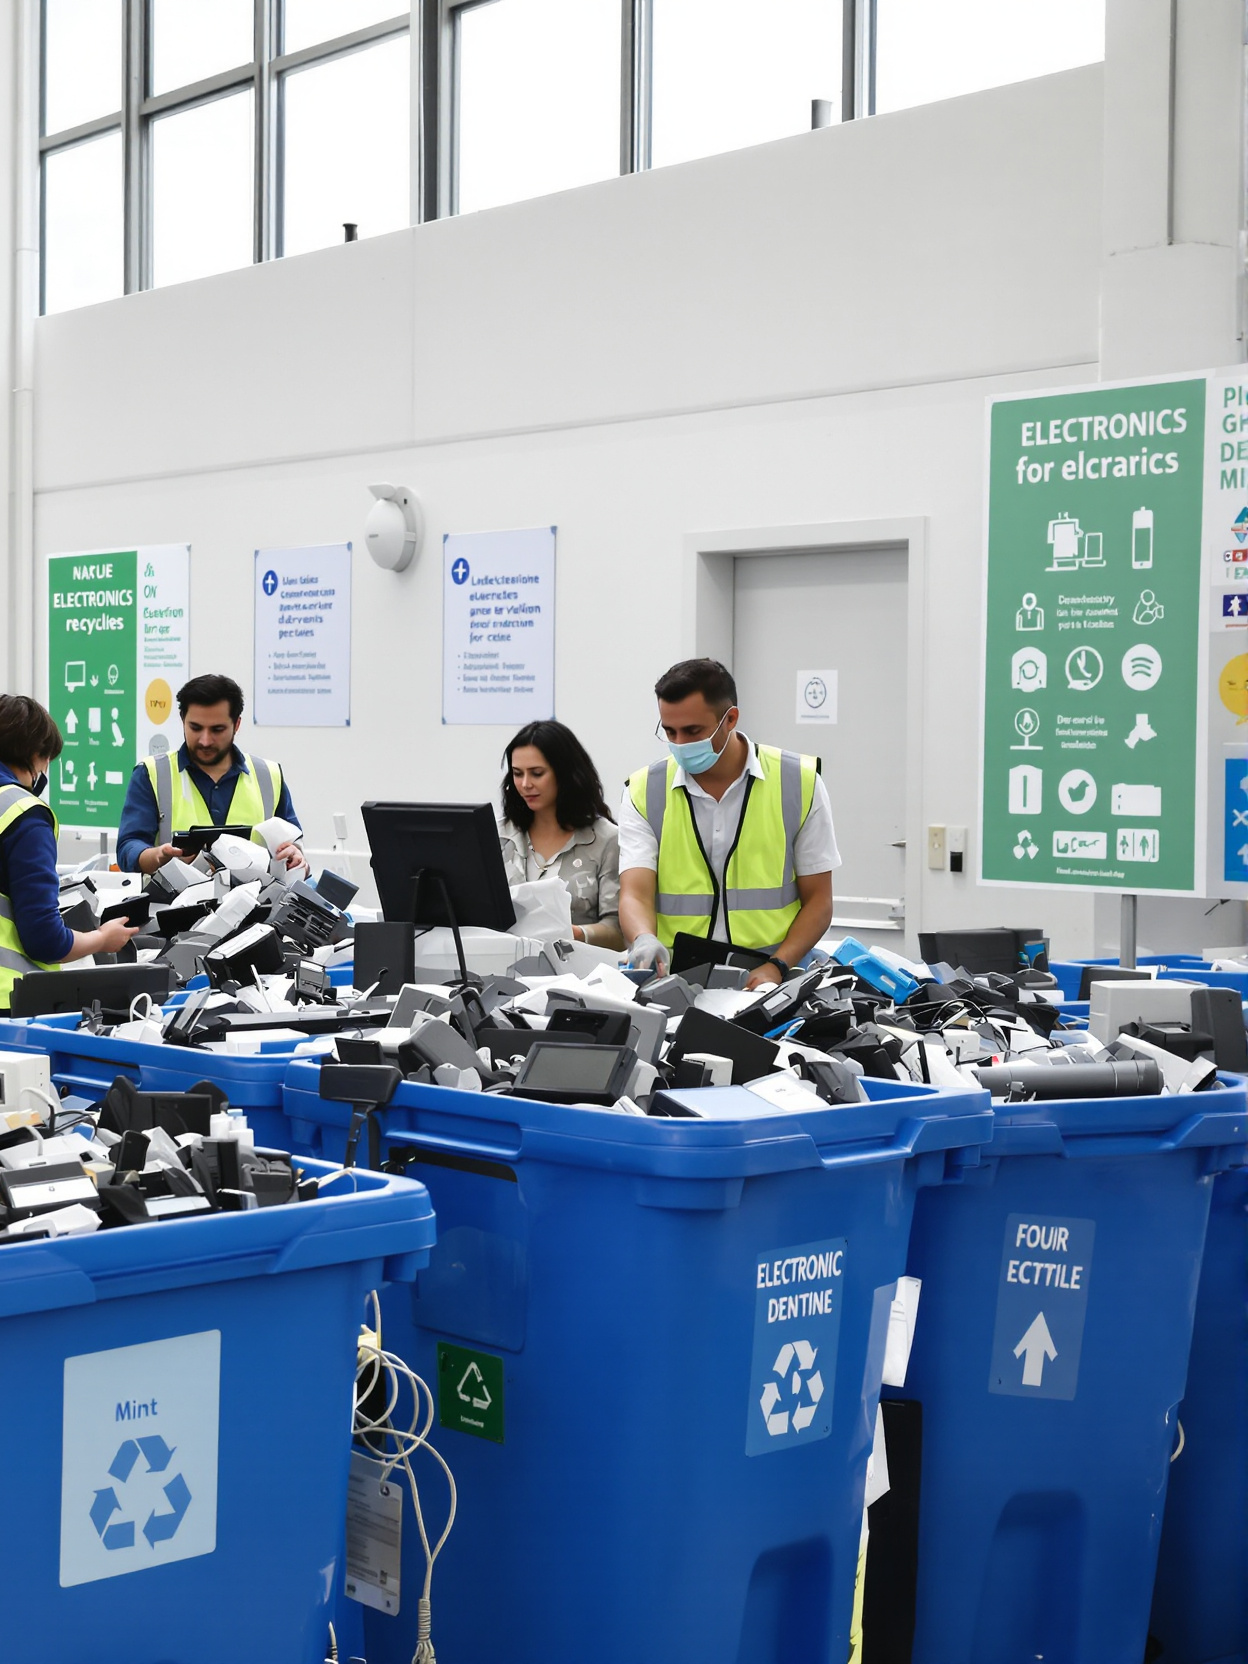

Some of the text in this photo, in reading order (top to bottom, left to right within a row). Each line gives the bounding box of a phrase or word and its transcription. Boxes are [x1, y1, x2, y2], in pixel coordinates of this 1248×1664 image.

[1021, 408, 1187, 447] ELECTRONICS
[1016, 456, 1054, 484] for
[53, 589, 133, 608] ELECTRONICS
[756, 1250, 843, 1289] ELECTRONIC
[767, 1289, 833, 1324] DENTINE
[115, 1398, 158, 1422] Mint
